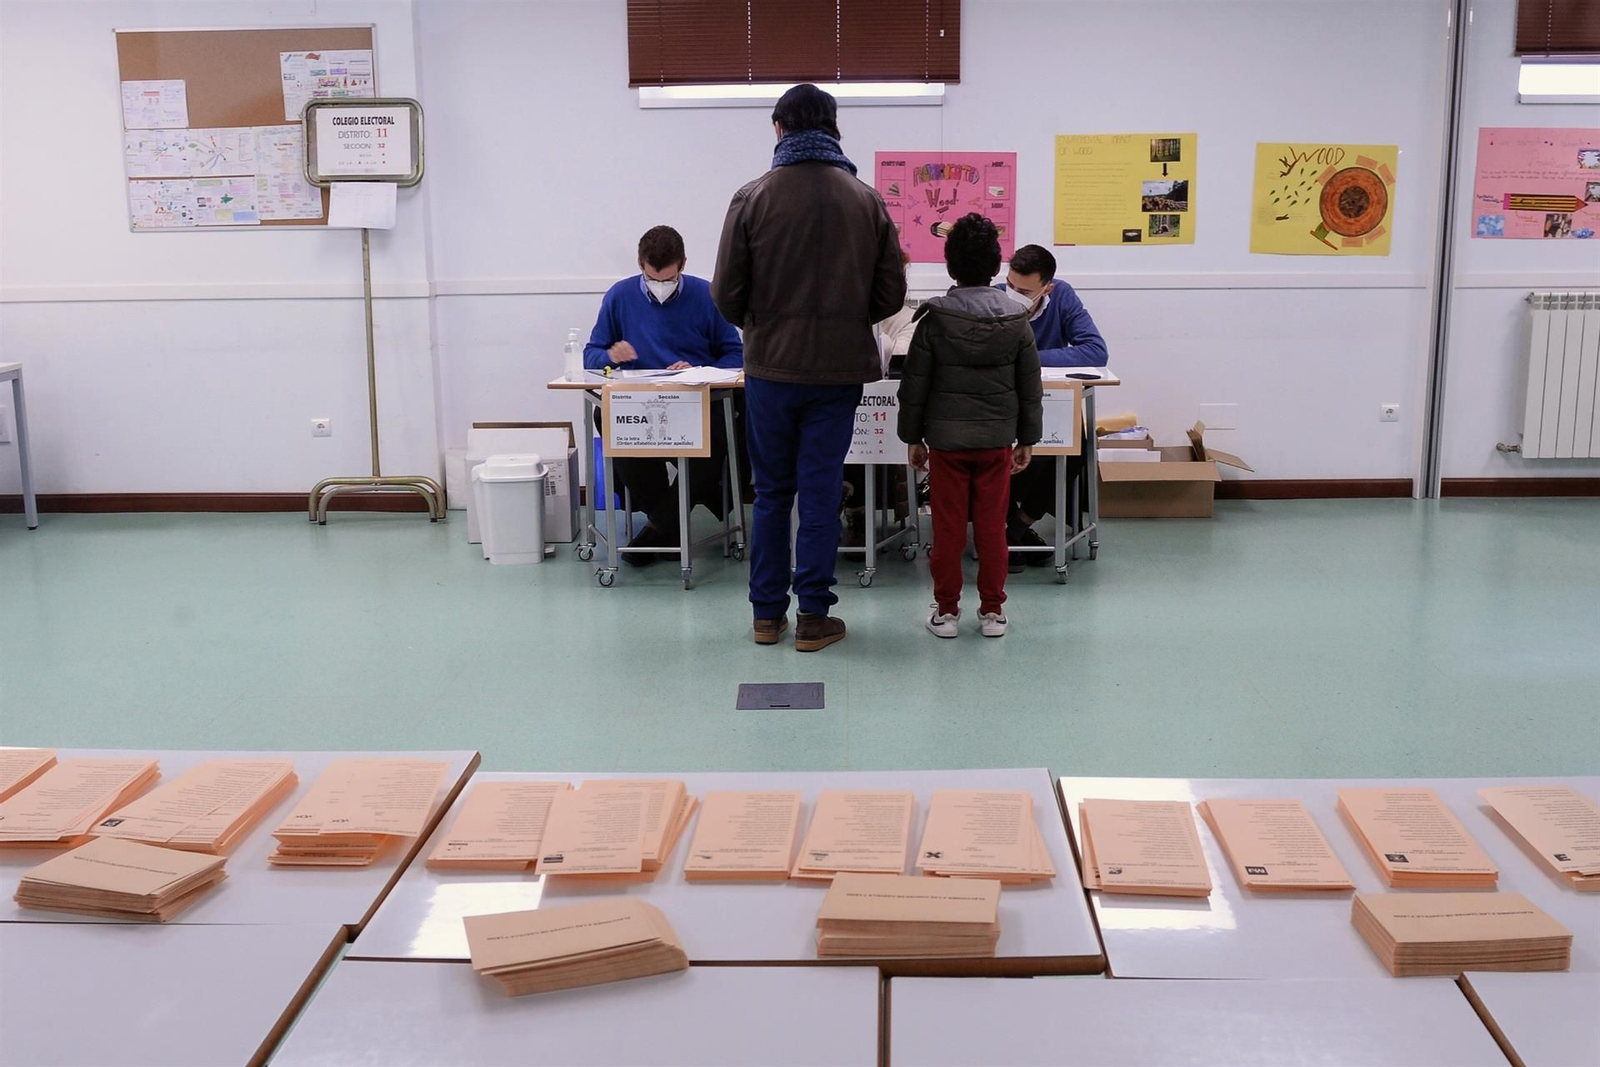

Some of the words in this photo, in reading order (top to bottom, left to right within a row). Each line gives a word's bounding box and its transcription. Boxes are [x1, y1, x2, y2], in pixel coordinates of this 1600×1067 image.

[332, 116, 359, 125] COLEGIO
[361, 116, 394, 125] ELECTORAL
[338, 130, 372, 139] DISTRITO:
[376, 128, 387, 138] 11
[1289, 146, 1345, 166] WOOD
[926, 188, 958, 208] Wood
[858, 396, 896, 406] LECTORAL
[616, 416, 648, 424] MESA
[873, 412, 886, 421] 11
[1052, 432, 1059, 440] K
